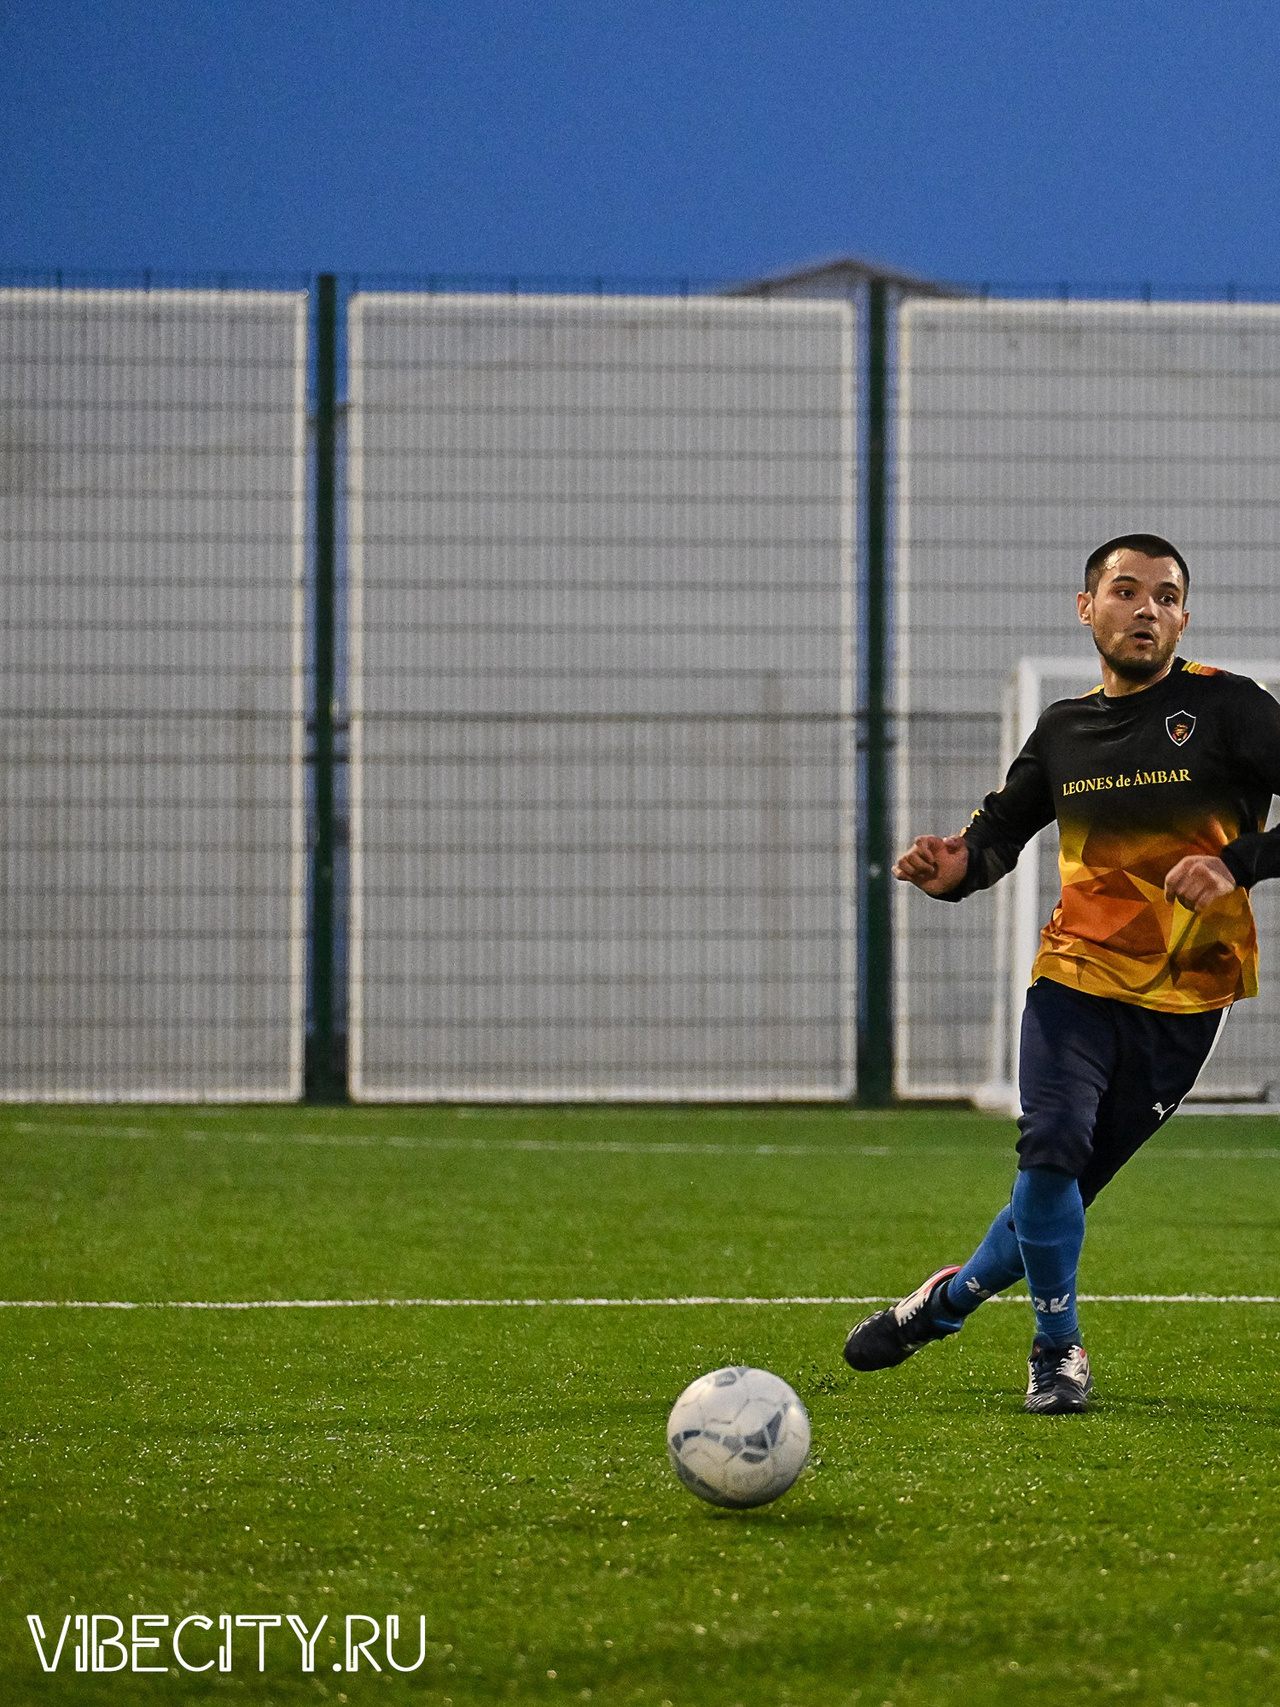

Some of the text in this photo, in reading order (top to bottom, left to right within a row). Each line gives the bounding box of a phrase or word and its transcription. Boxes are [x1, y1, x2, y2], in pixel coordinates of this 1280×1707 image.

[1062, 769, 1192, 797] LEONES de ÁMBAR
